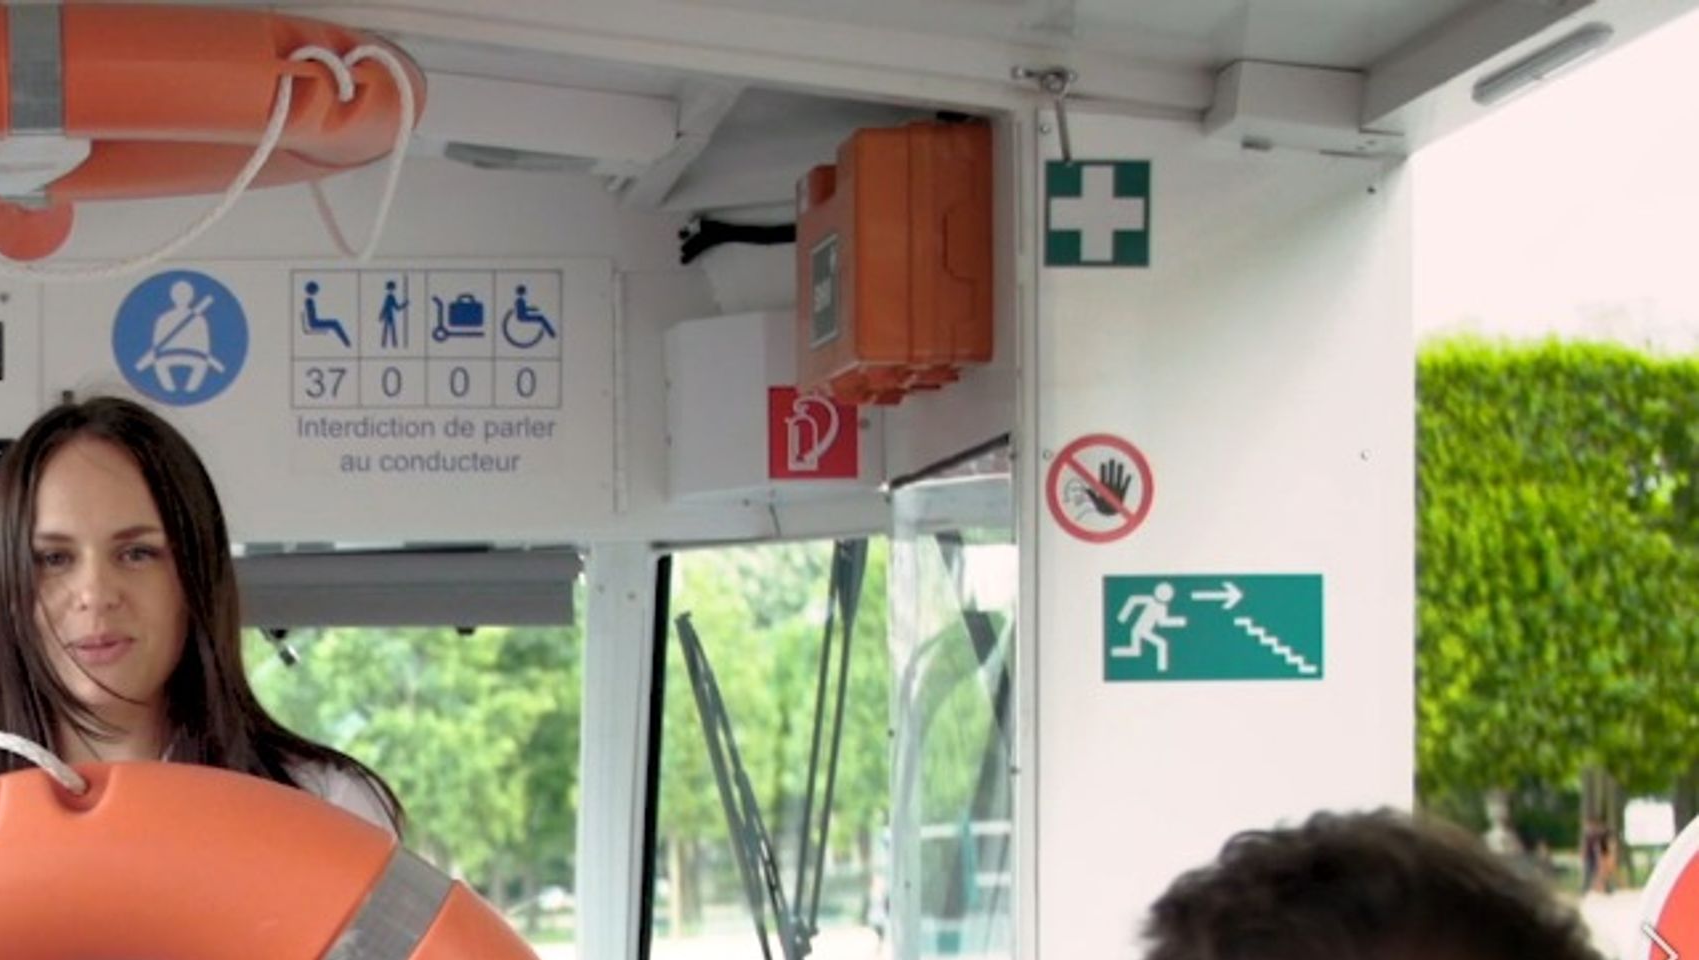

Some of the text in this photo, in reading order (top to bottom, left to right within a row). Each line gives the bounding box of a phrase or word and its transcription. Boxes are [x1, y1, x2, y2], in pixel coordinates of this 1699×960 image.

[305, 366, 537, 399] 37 0 0 0
[297, 415, 557, 444] Interdiction de parler
[340, 450, 521, 473] au conducteur
